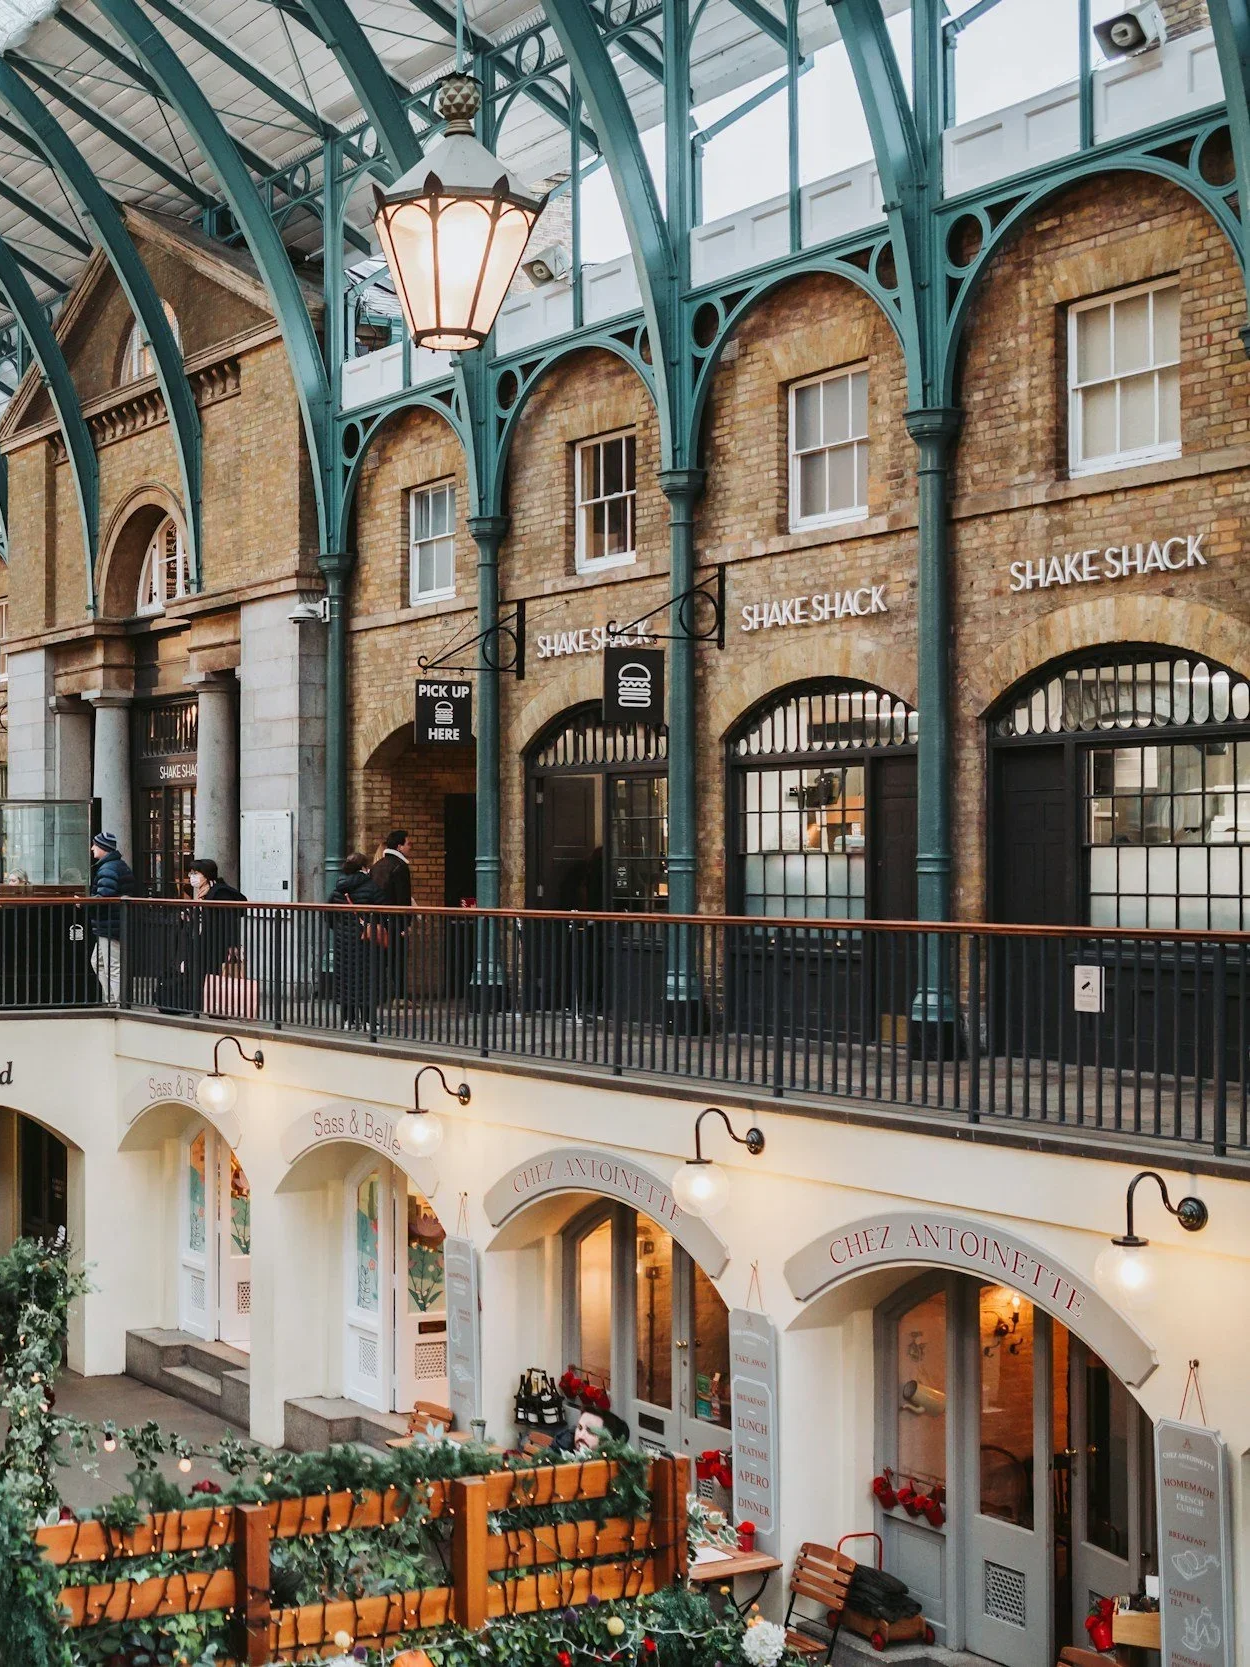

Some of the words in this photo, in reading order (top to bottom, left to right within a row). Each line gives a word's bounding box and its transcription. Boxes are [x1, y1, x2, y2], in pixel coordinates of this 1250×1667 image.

[1009, 549, 1100, 592] SHAKE
[1104, 533, 1208, 579] SHACK
[741, 596, 809, 632] SHAKE
[810, 584, 889, 622] SHACK
[536, 628, 591, 659] SHAKE
[591, 619, 652, 651] SHACK
[418, 684, 448, 698] PICK
[451, 685, 470, 698] UP
[428, 727, 460, 741] HERE
[159, 764, 181, 779] SHAKE
[181, 763, 198, 778] SHAC
[148, 1077, 173, 1100] Sass
[175, 1074, 183, 1097] &
[313, 1111, 345, 1138] Sass
[349, 1108, 360, 1135] &
[363, 1112, 401, 1156] Belle
[512, 1160, 555, 1194] CHEZ
[563, 1157, 684, 1229] ANTOINETTE
[829, 1225, 894, 1265] CHEZ
[906, 1223, 1086, 1319] ANTOINETTE
[734, 1353, 750, 1365] TAKE
[737, 1416, 768, 1436] LUNCH
[738, 1443, 769, 1462] TEATIME
[738, 1469, 770, 1489] APERO
[1163, 1478, 1216, 1499] HOMEMADE
[738, 1496, 771, 1518] DINNER
[1176, 1492, 1204, 1507] FRENCH
[1176, 1502, 1205, 1518] CUISINE
[1168, 1529, 1207, 1548] BREAKFAST
[1170, 1598, 1183, 1608] TEA
